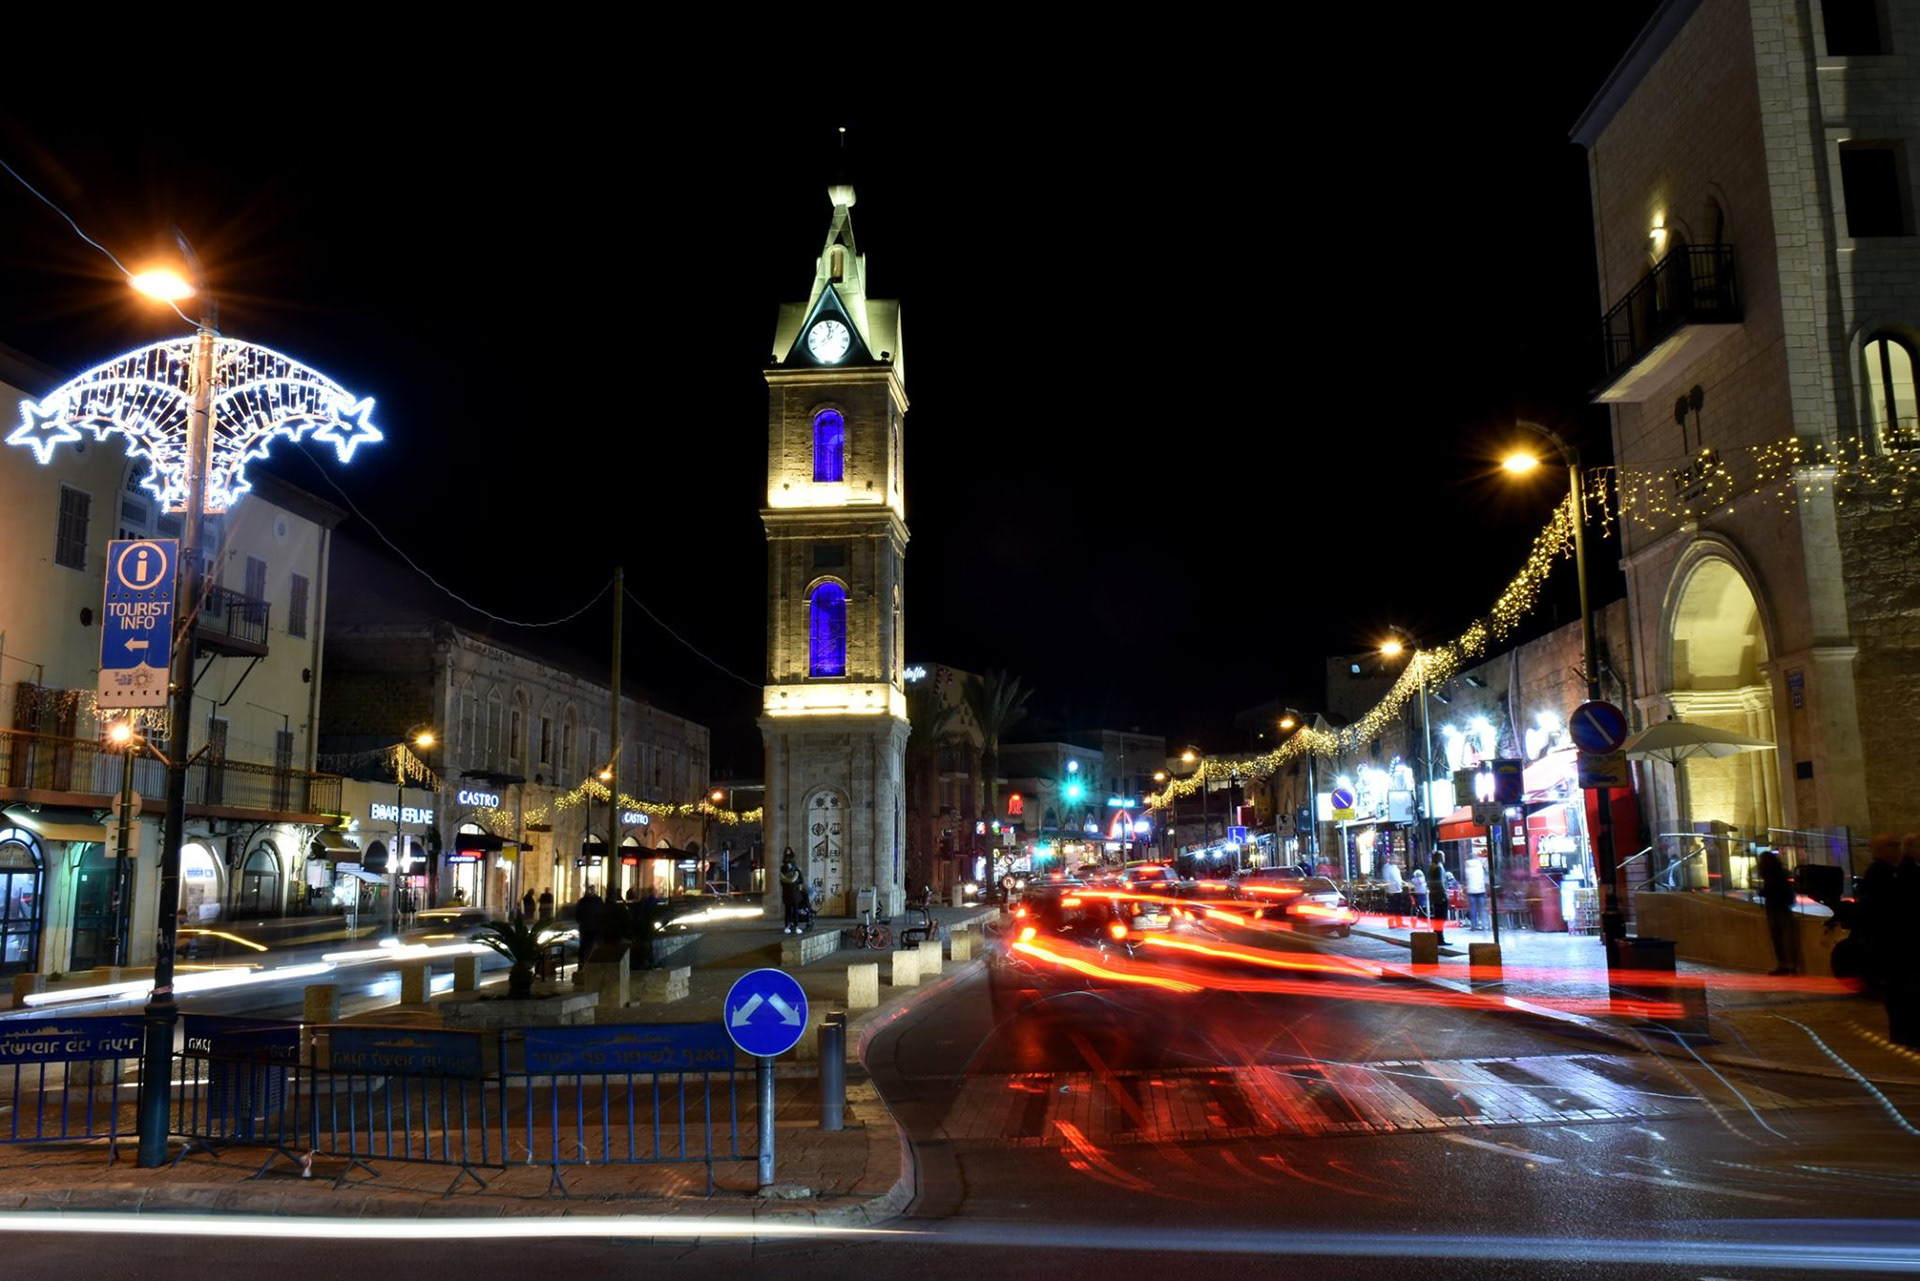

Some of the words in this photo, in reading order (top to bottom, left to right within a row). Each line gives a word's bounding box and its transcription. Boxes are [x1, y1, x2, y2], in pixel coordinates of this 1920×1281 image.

[108, 602, 171, 616] TOURIST
[120, 615, 156, 630] INFO
[459, 790, 499, 808] CASTRO
[624, 811, 649, 826] CASTRO
[614, 1046, 676, 1065] לשיפור
[681, 1048, 730, 1067] האגף
